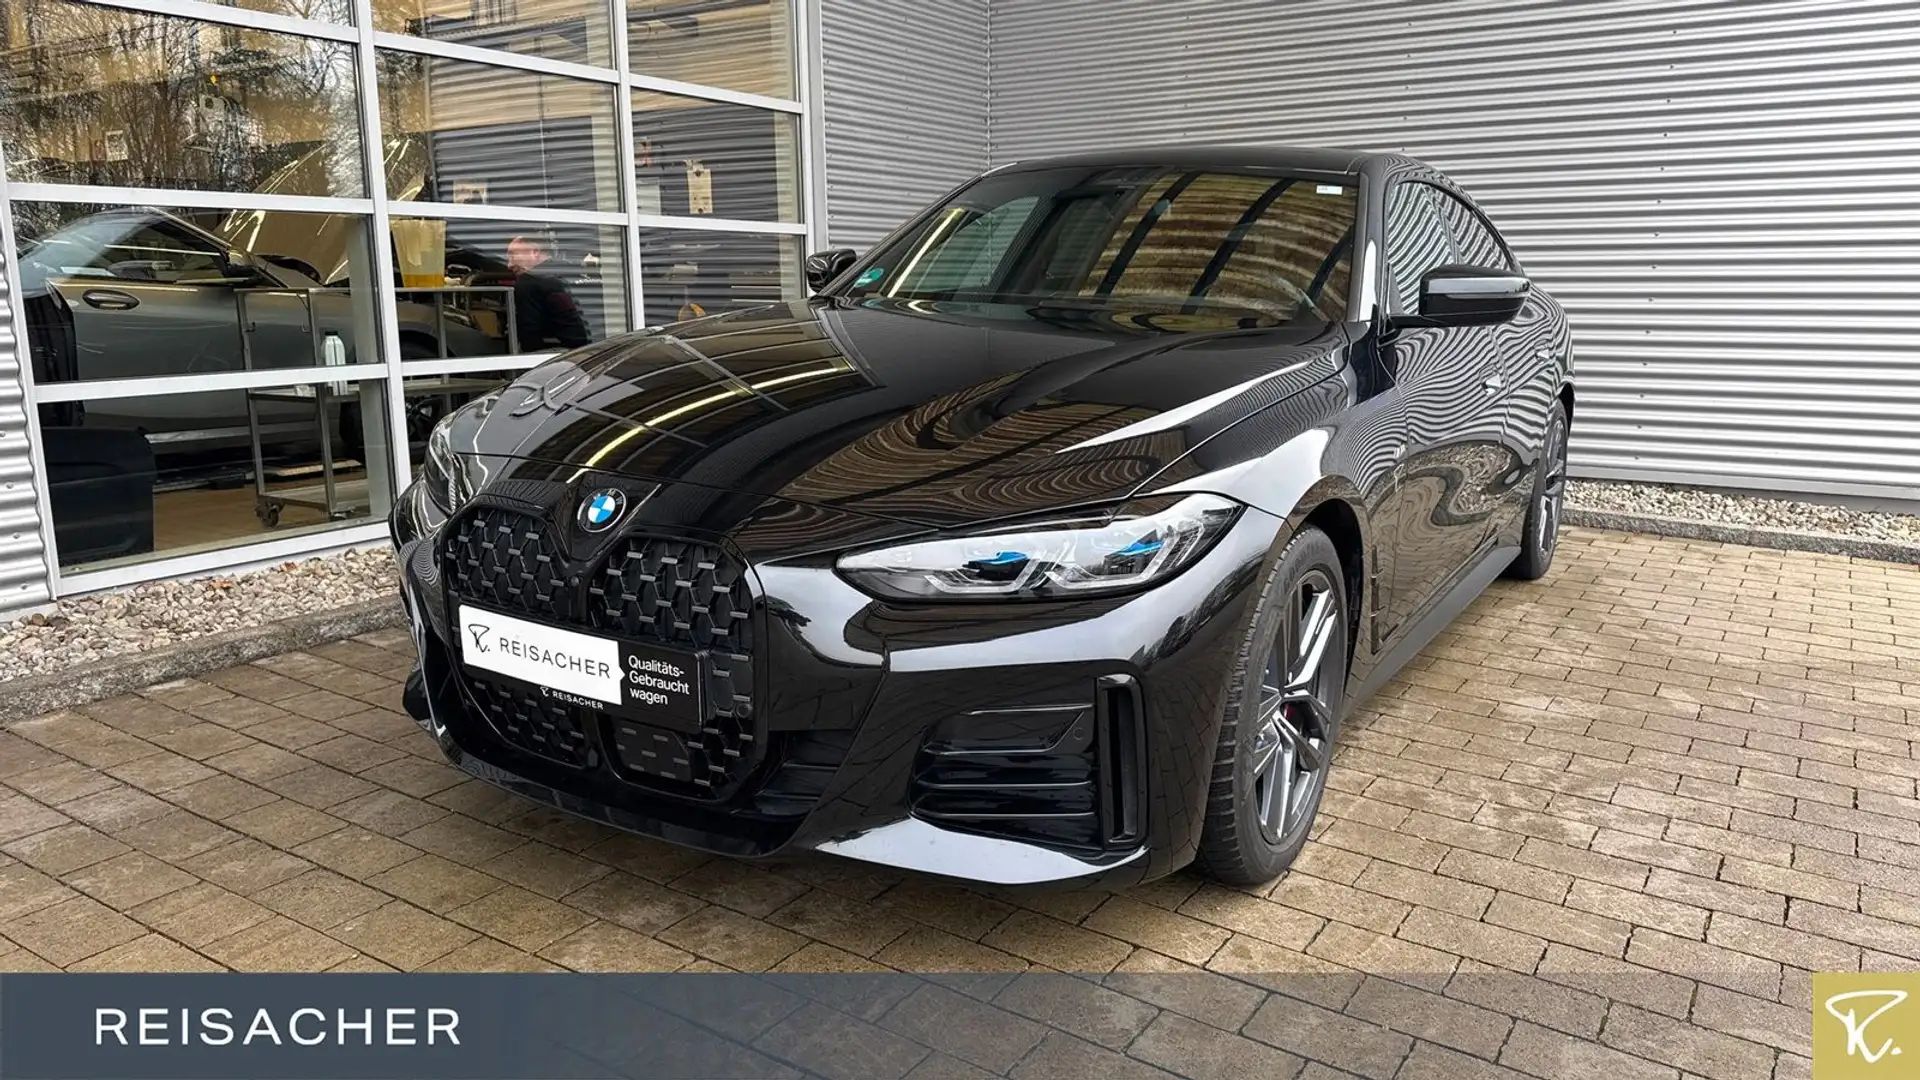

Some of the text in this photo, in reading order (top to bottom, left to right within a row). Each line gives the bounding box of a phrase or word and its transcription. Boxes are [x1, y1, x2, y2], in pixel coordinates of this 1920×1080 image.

[499, 637, 611, 679] REISACHER
[628, 655, 685, 677] Qualitäts-
[629, 670, 690, 695] Gebraucht
[552, 690, 604, 711] REISACHER
[629, 687, 668, 705] wagen
